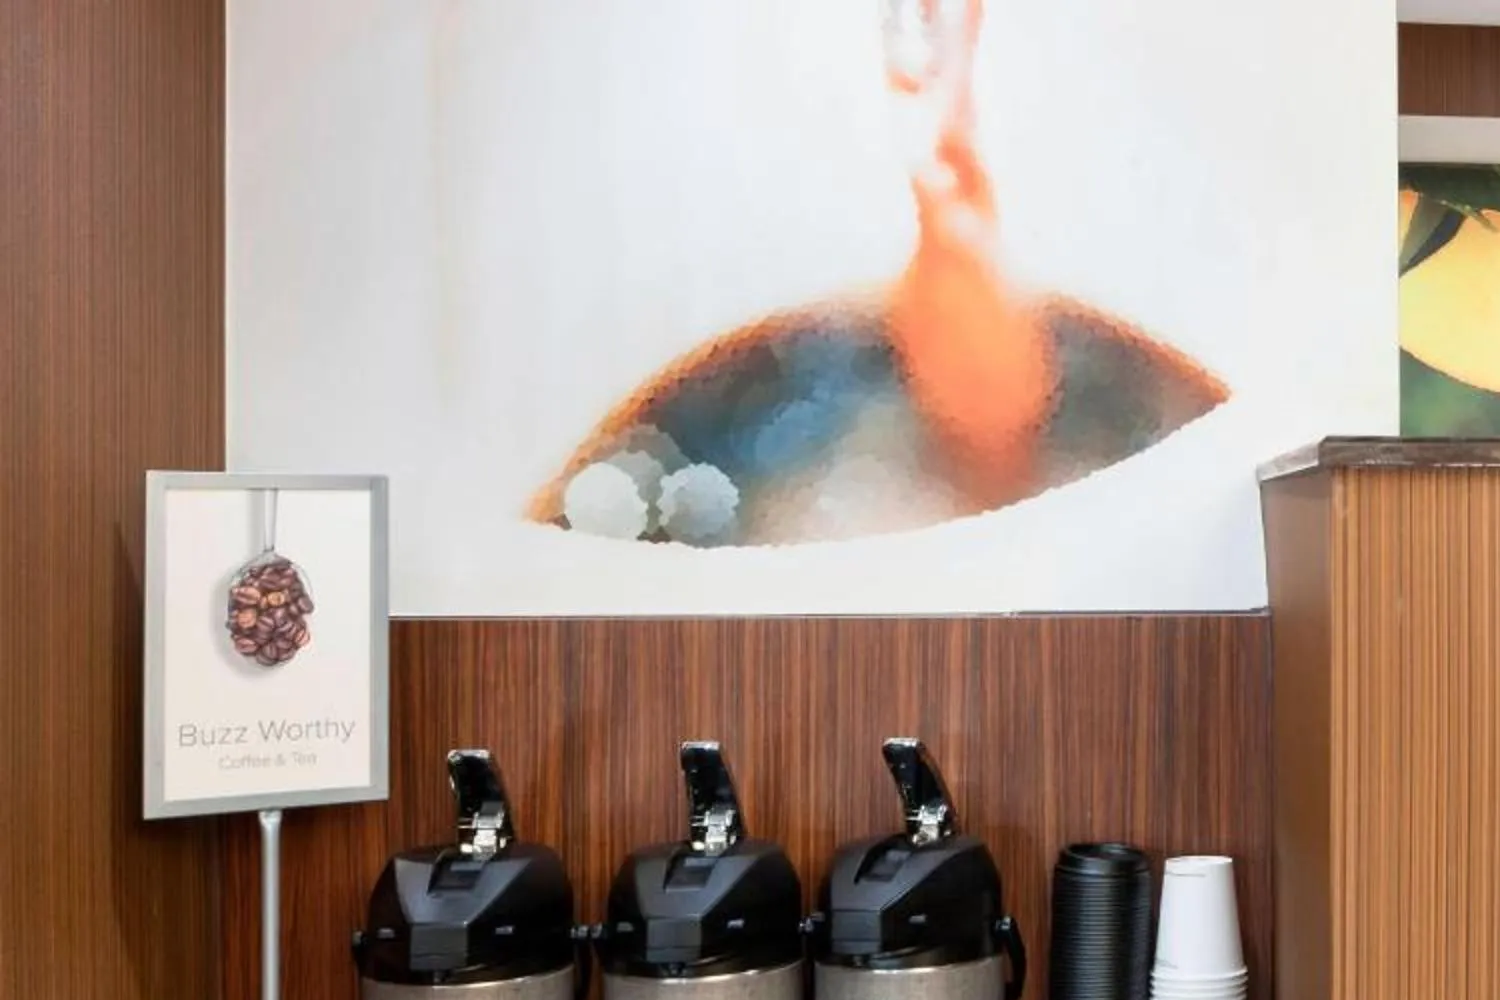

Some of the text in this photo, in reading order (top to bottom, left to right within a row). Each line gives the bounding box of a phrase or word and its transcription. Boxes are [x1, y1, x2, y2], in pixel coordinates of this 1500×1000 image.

[178, 718, 356, 747] Buzz Worthy
[218, 751, 318, 770] Coffee & Tea
